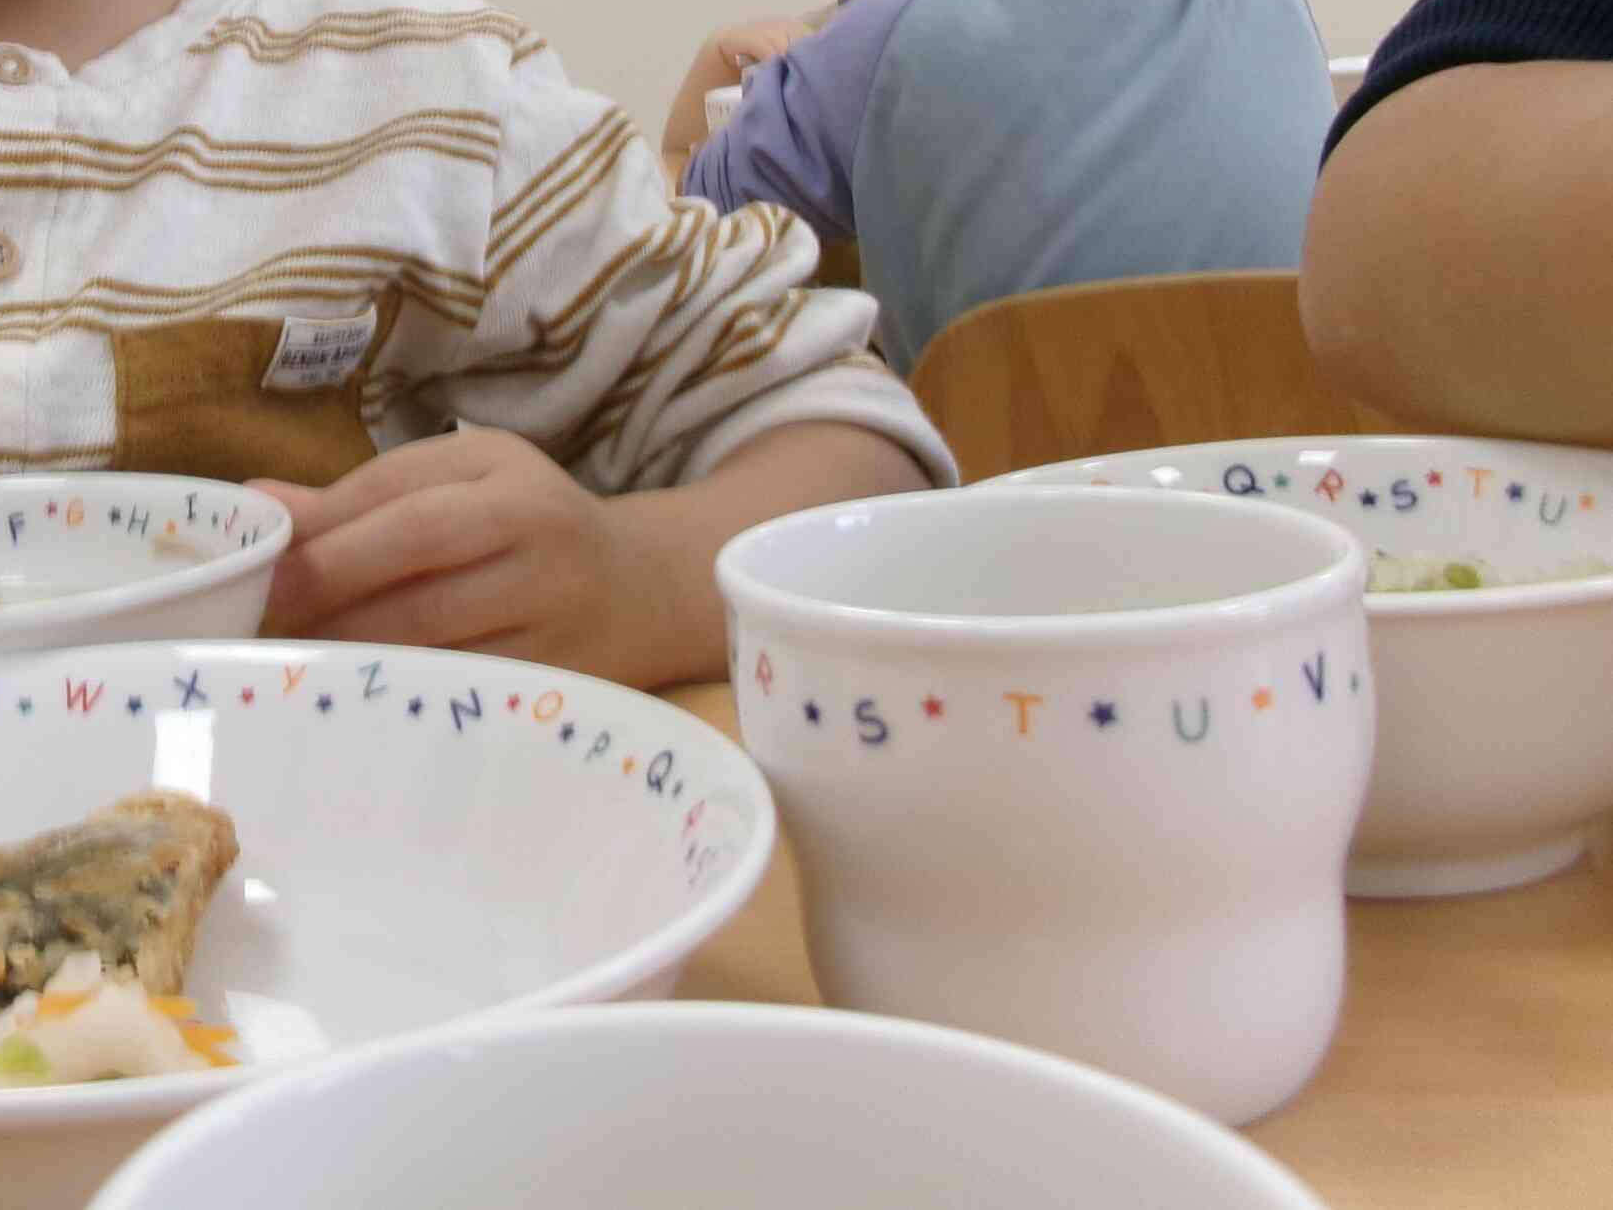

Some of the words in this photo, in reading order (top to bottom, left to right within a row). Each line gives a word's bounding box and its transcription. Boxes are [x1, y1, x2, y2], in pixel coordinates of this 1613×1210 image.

[7, 511, 25, 545] F
[127, 504, 150, 539] H
[186, 491, 198, 522] I
[1223, 463, 1265, 495] Q
[1315, 468, 1344, 502] R
[1390, 479, 1418, 511] S
[1467, 468, 1491, 500] T
[1539, 492, 1567, 526] U
[65, 676, 105, 714] W
[173, 669, 207, 710] X
[282, 663, 307, 695] Y
[358, 661, 388, 700] Z
[449, 687, 482, 734] N
[531, 690, 564, 724] O
[646, 749, 674, 794] Q
[854, 698, 889, 744] S
[1002, 691, 1045, 735] T
[1172, 695, 1209, 744] U
[1302, 653, 1326, 703] V
